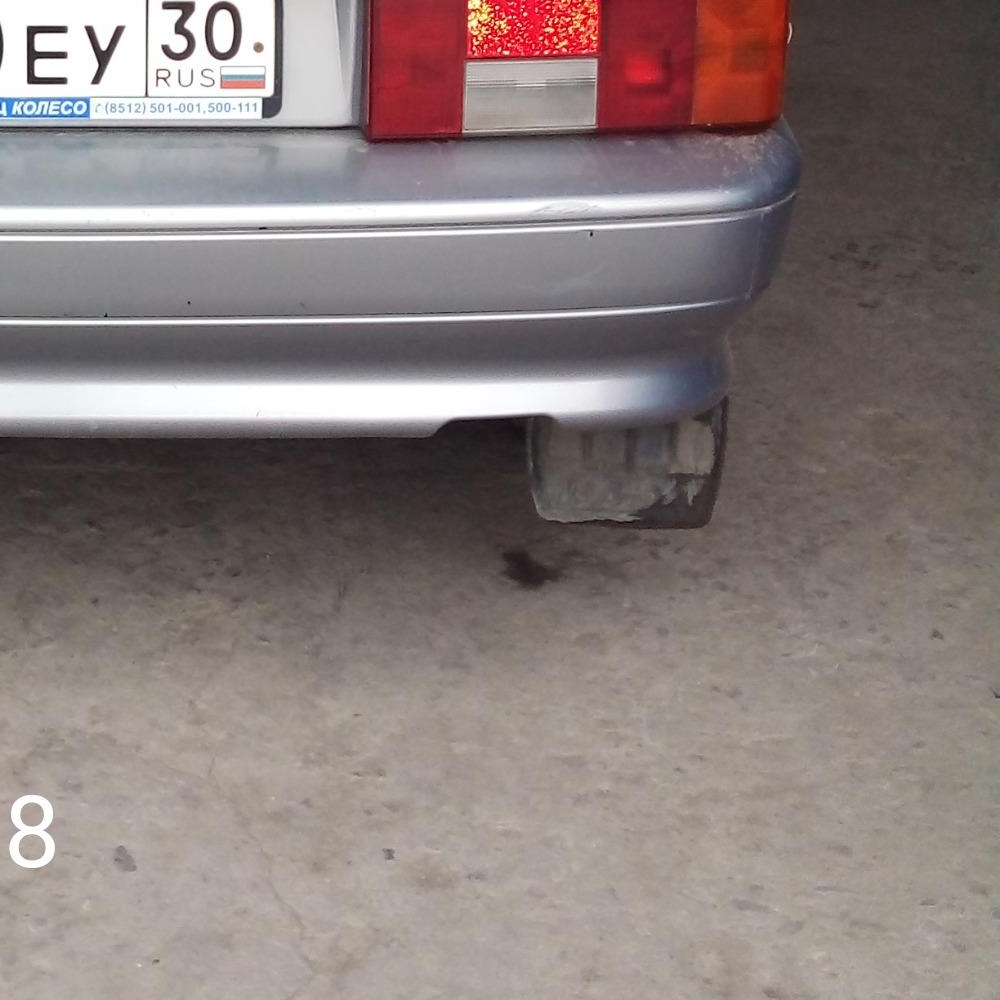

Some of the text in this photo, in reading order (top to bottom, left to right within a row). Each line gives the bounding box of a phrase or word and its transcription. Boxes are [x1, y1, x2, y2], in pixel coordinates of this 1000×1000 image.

[161, 1, 242, 61] 30
[156, 68, 215, 88] RUS
[12, 100, 88, 116] КОЛЕСО
[104, 101, 147, 115] (8512)
